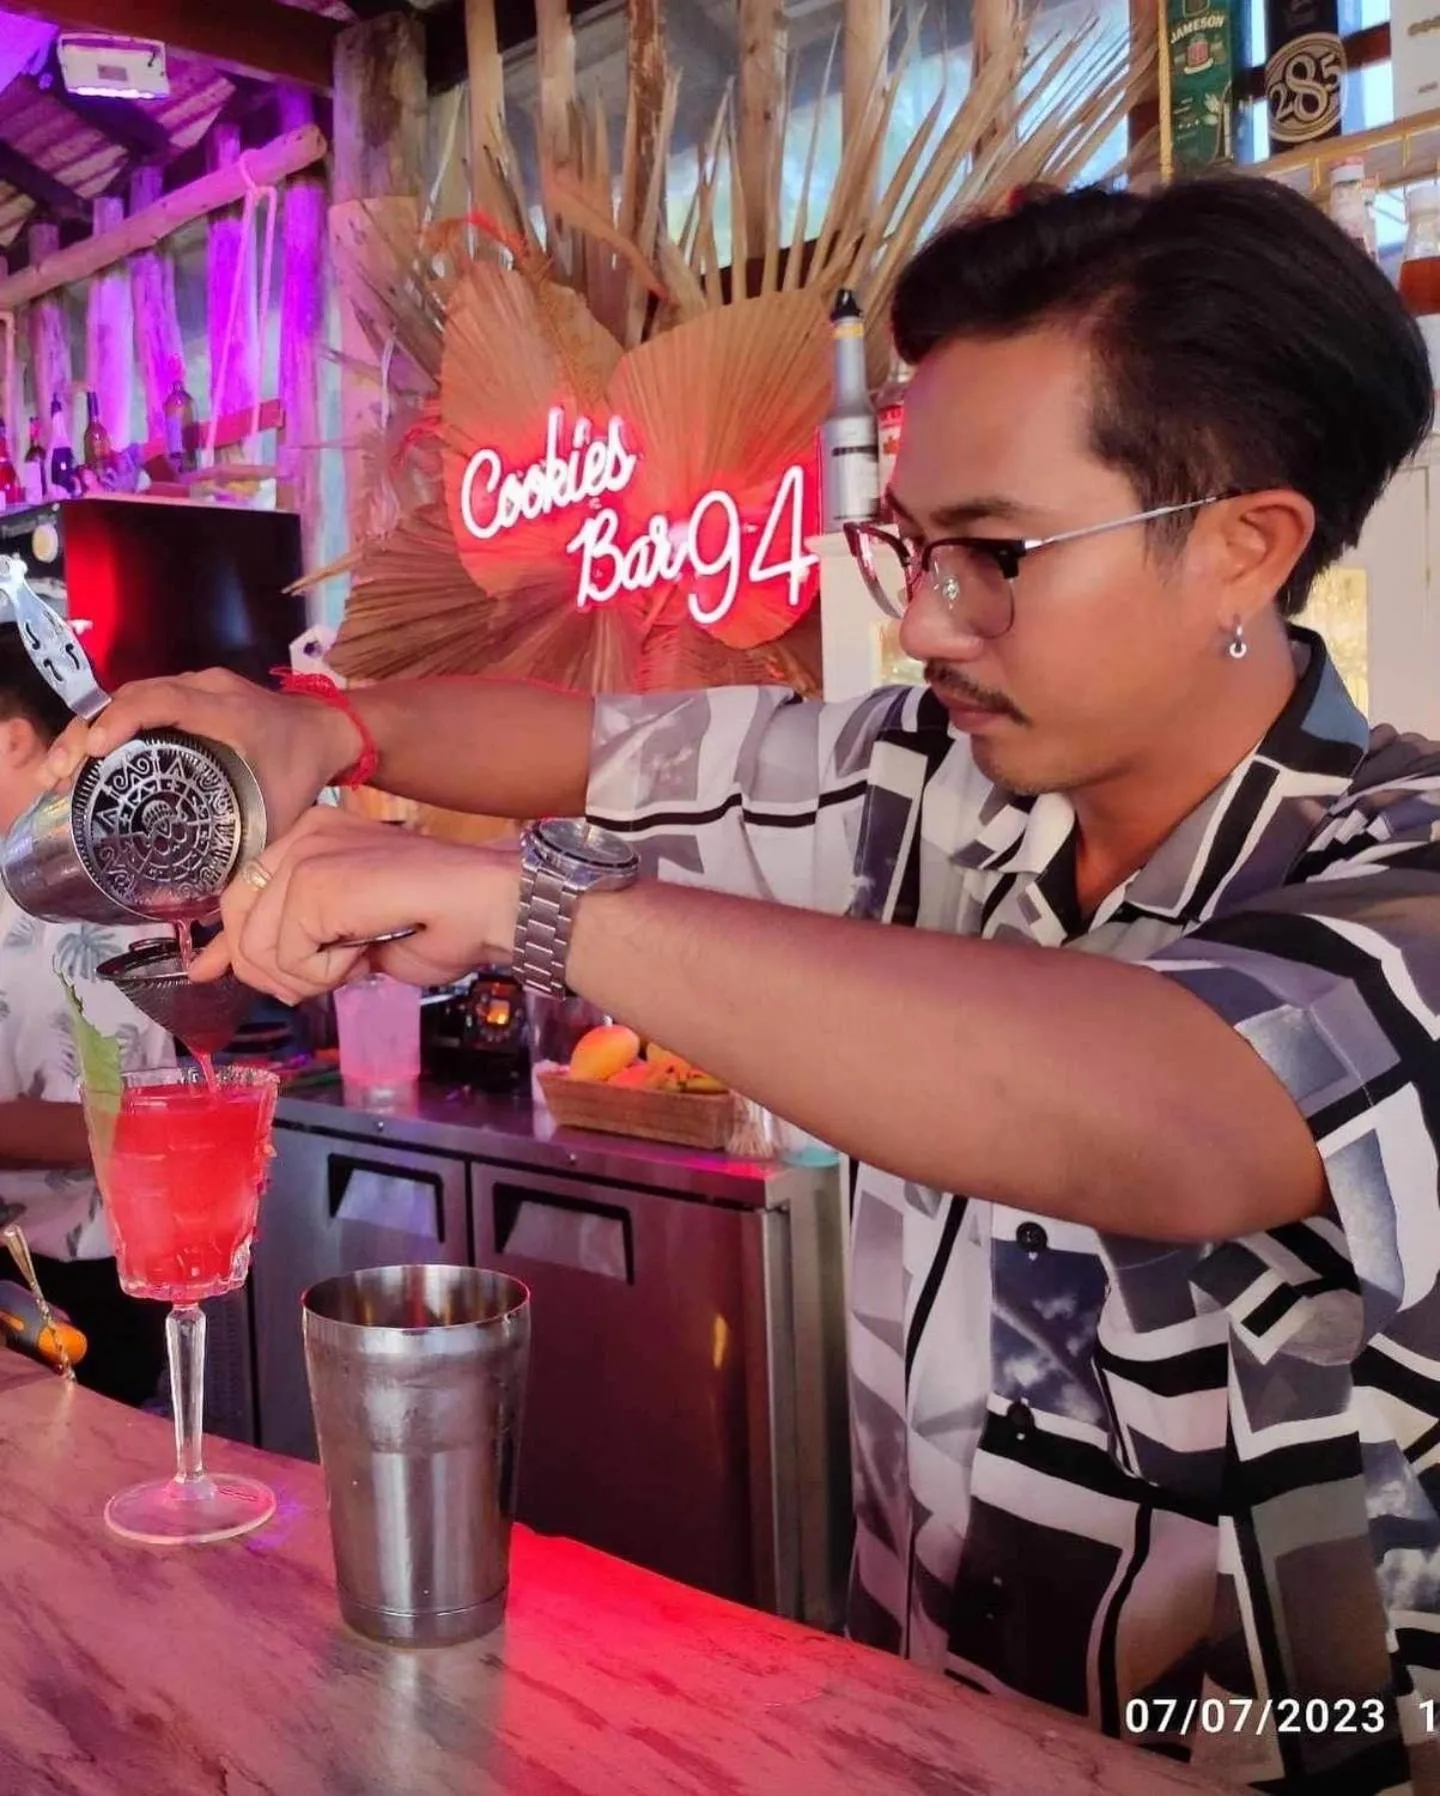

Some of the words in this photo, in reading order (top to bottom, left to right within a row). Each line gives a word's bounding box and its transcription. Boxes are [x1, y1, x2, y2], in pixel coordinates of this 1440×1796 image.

[1171, 14, 1224, 44] JAMESON
[1268, 51, 1341, 121] 285
[461, 406, 637, 539] Cookies
